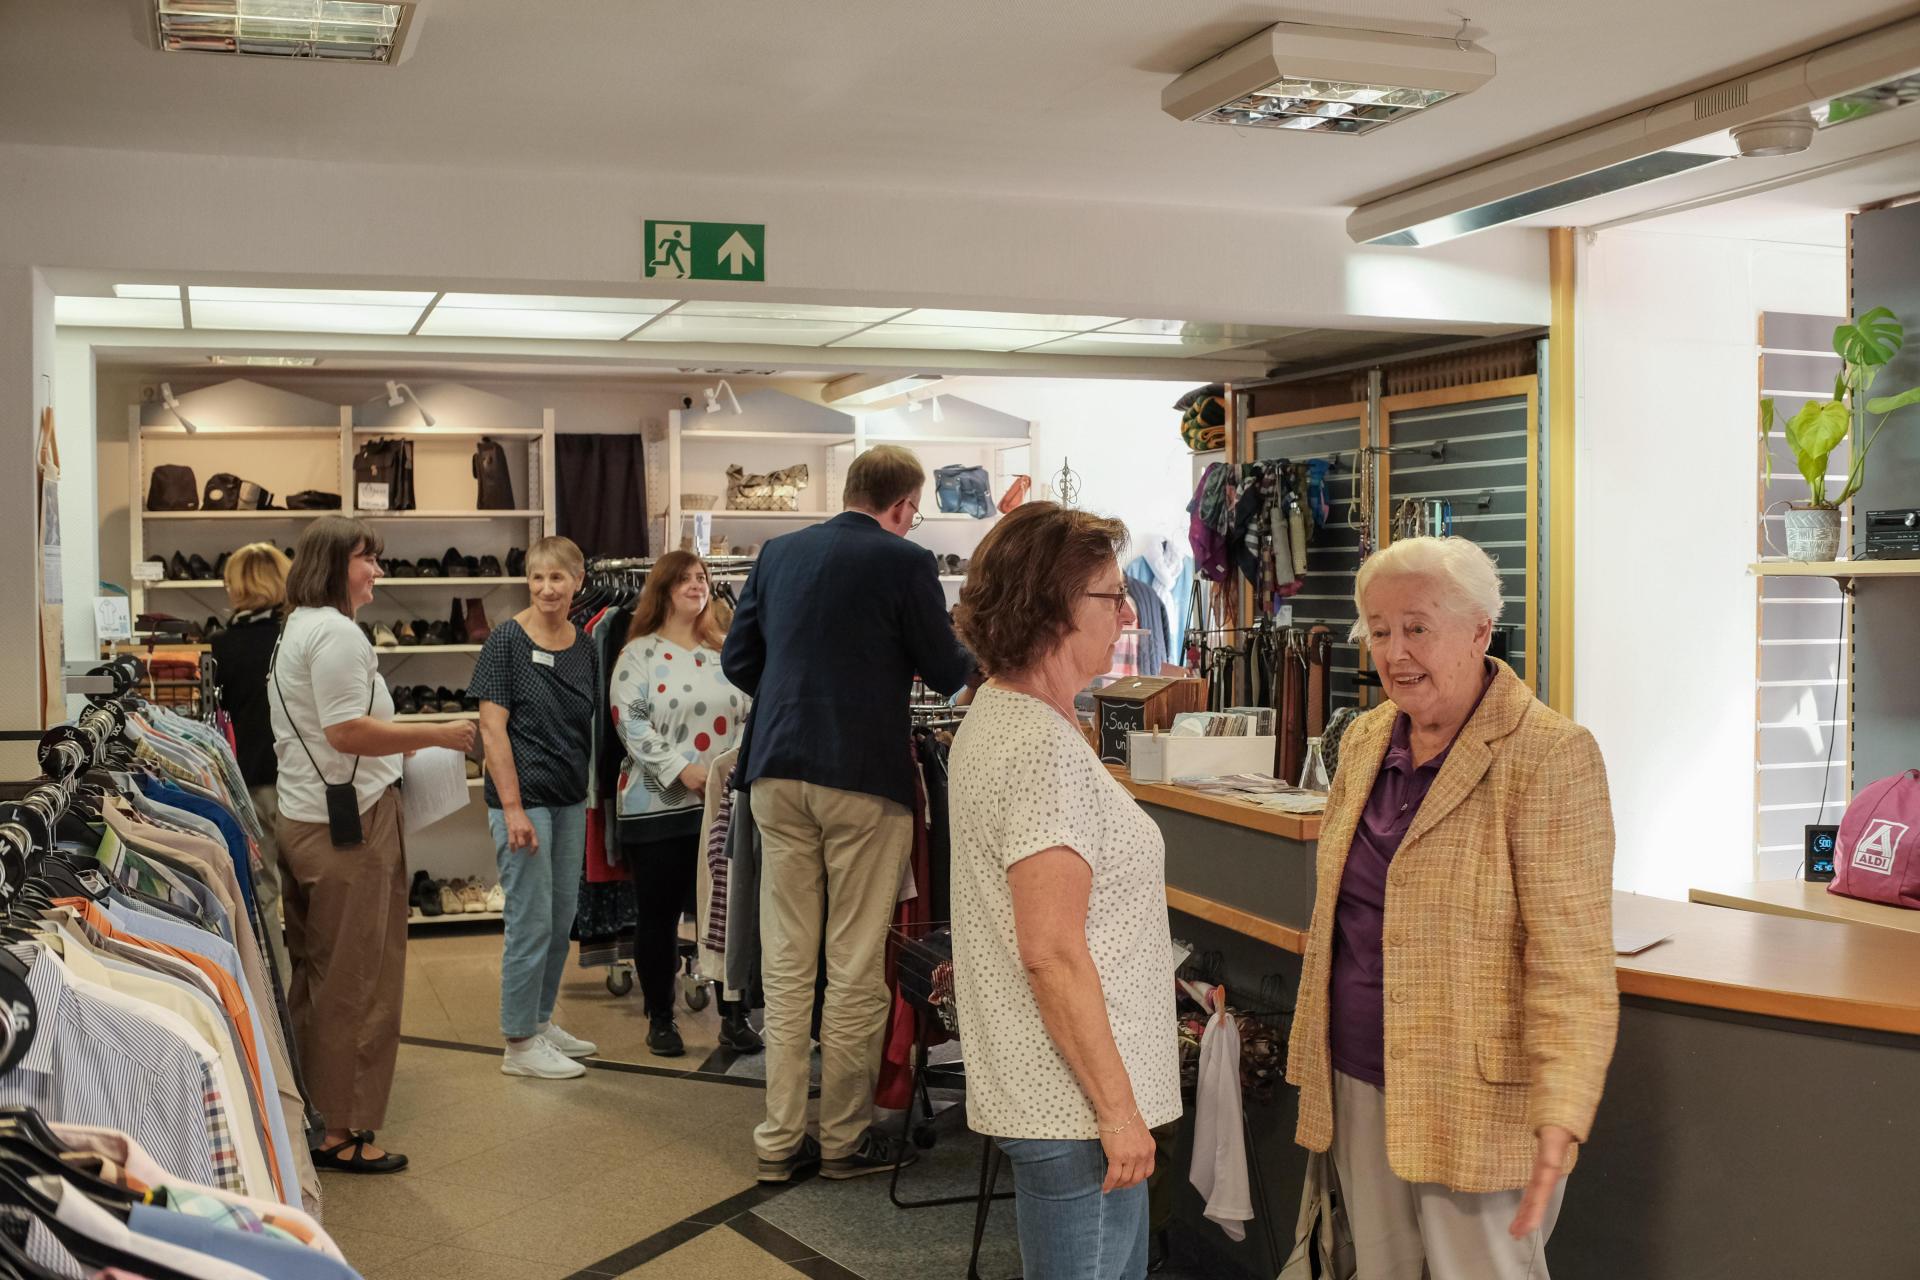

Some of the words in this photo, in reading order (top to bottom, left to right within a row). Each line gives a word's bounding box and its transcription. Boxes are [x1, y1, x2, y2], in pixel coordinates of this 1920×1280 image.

[63, 729, 76, 740] XL
[11, 808, 20, 821] L
[1858, 854, 1887, 869] ALDI
[12, 1000, 30, 1033] 46
